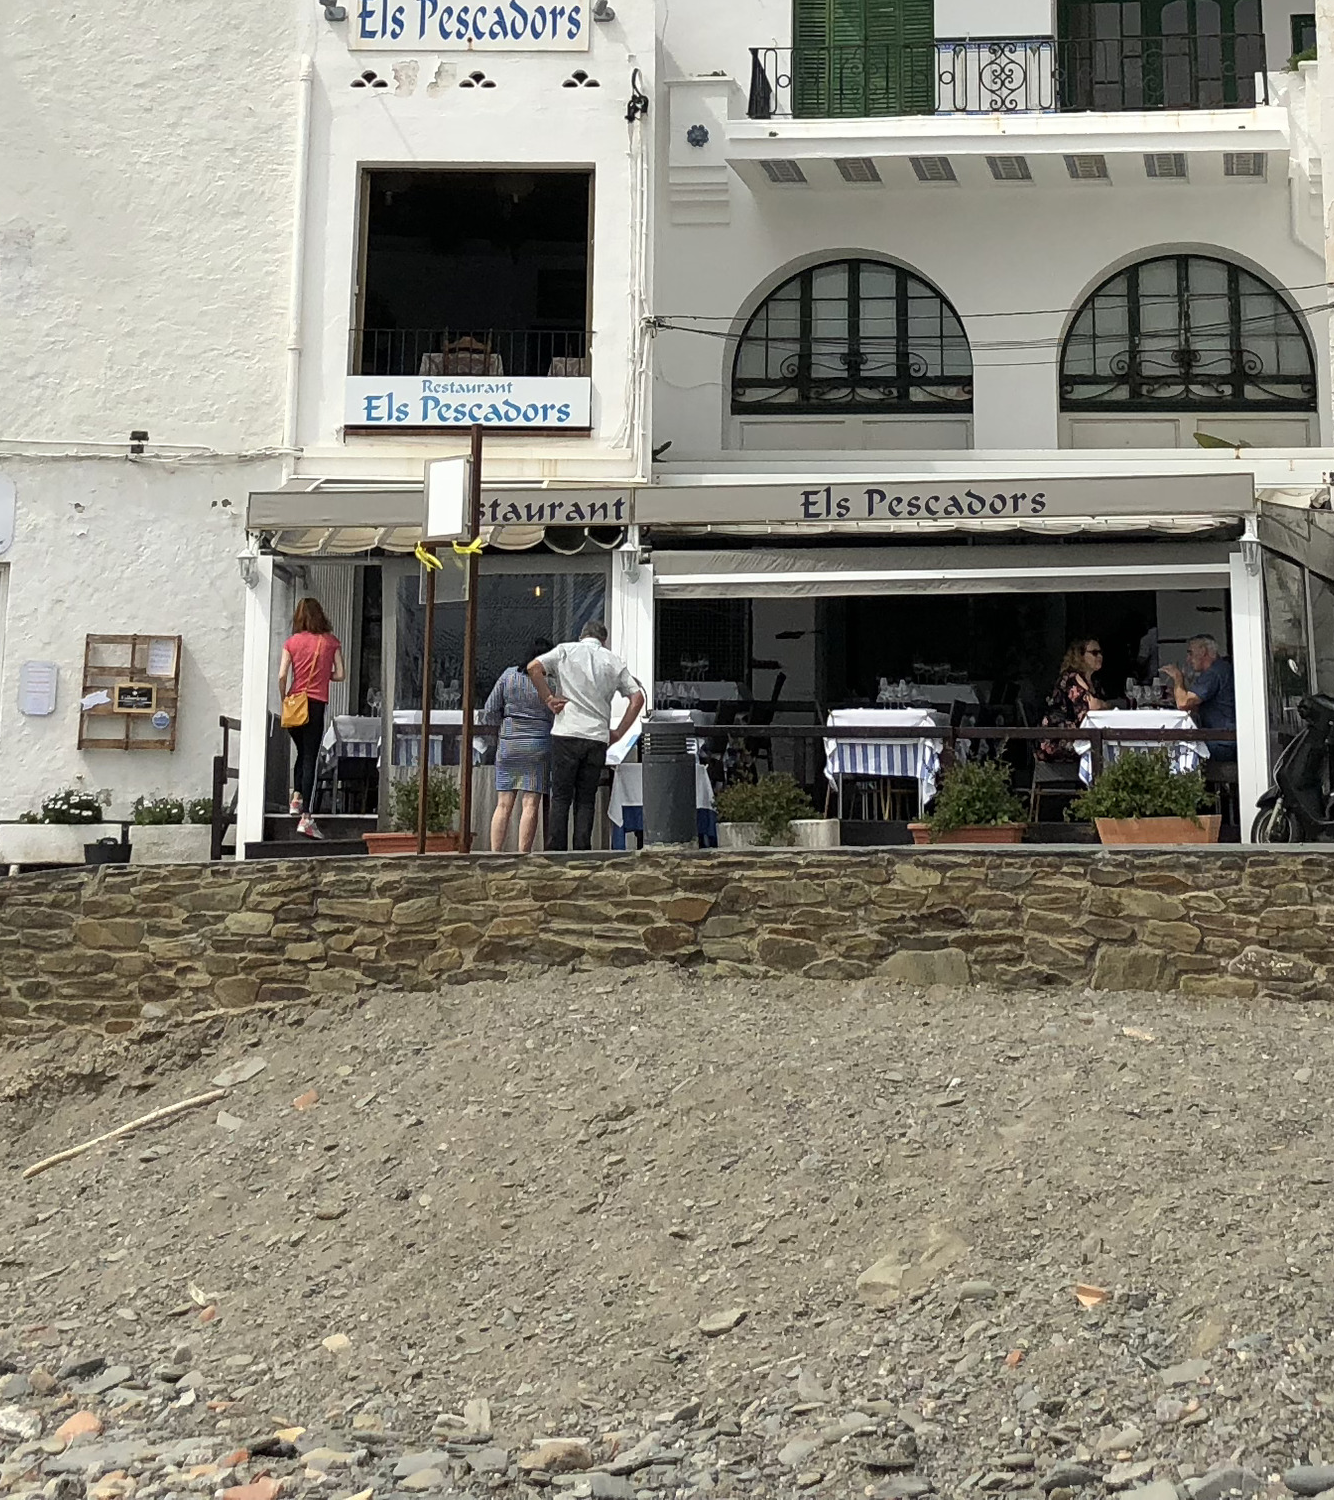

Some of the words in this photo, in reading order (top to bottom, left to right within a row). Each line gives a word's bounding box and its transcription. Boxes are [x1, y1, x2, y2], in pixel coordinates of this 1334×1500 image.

[421, 379, 514, 395] Restaurant
[362, 392, 410, 423] Els
[419, 395, 571, 423] Pescadors
[478, 496, 627, 523] staurant
[800, 485, 851, 519] Els
[863, 487, 1047, 518] Pescadors
